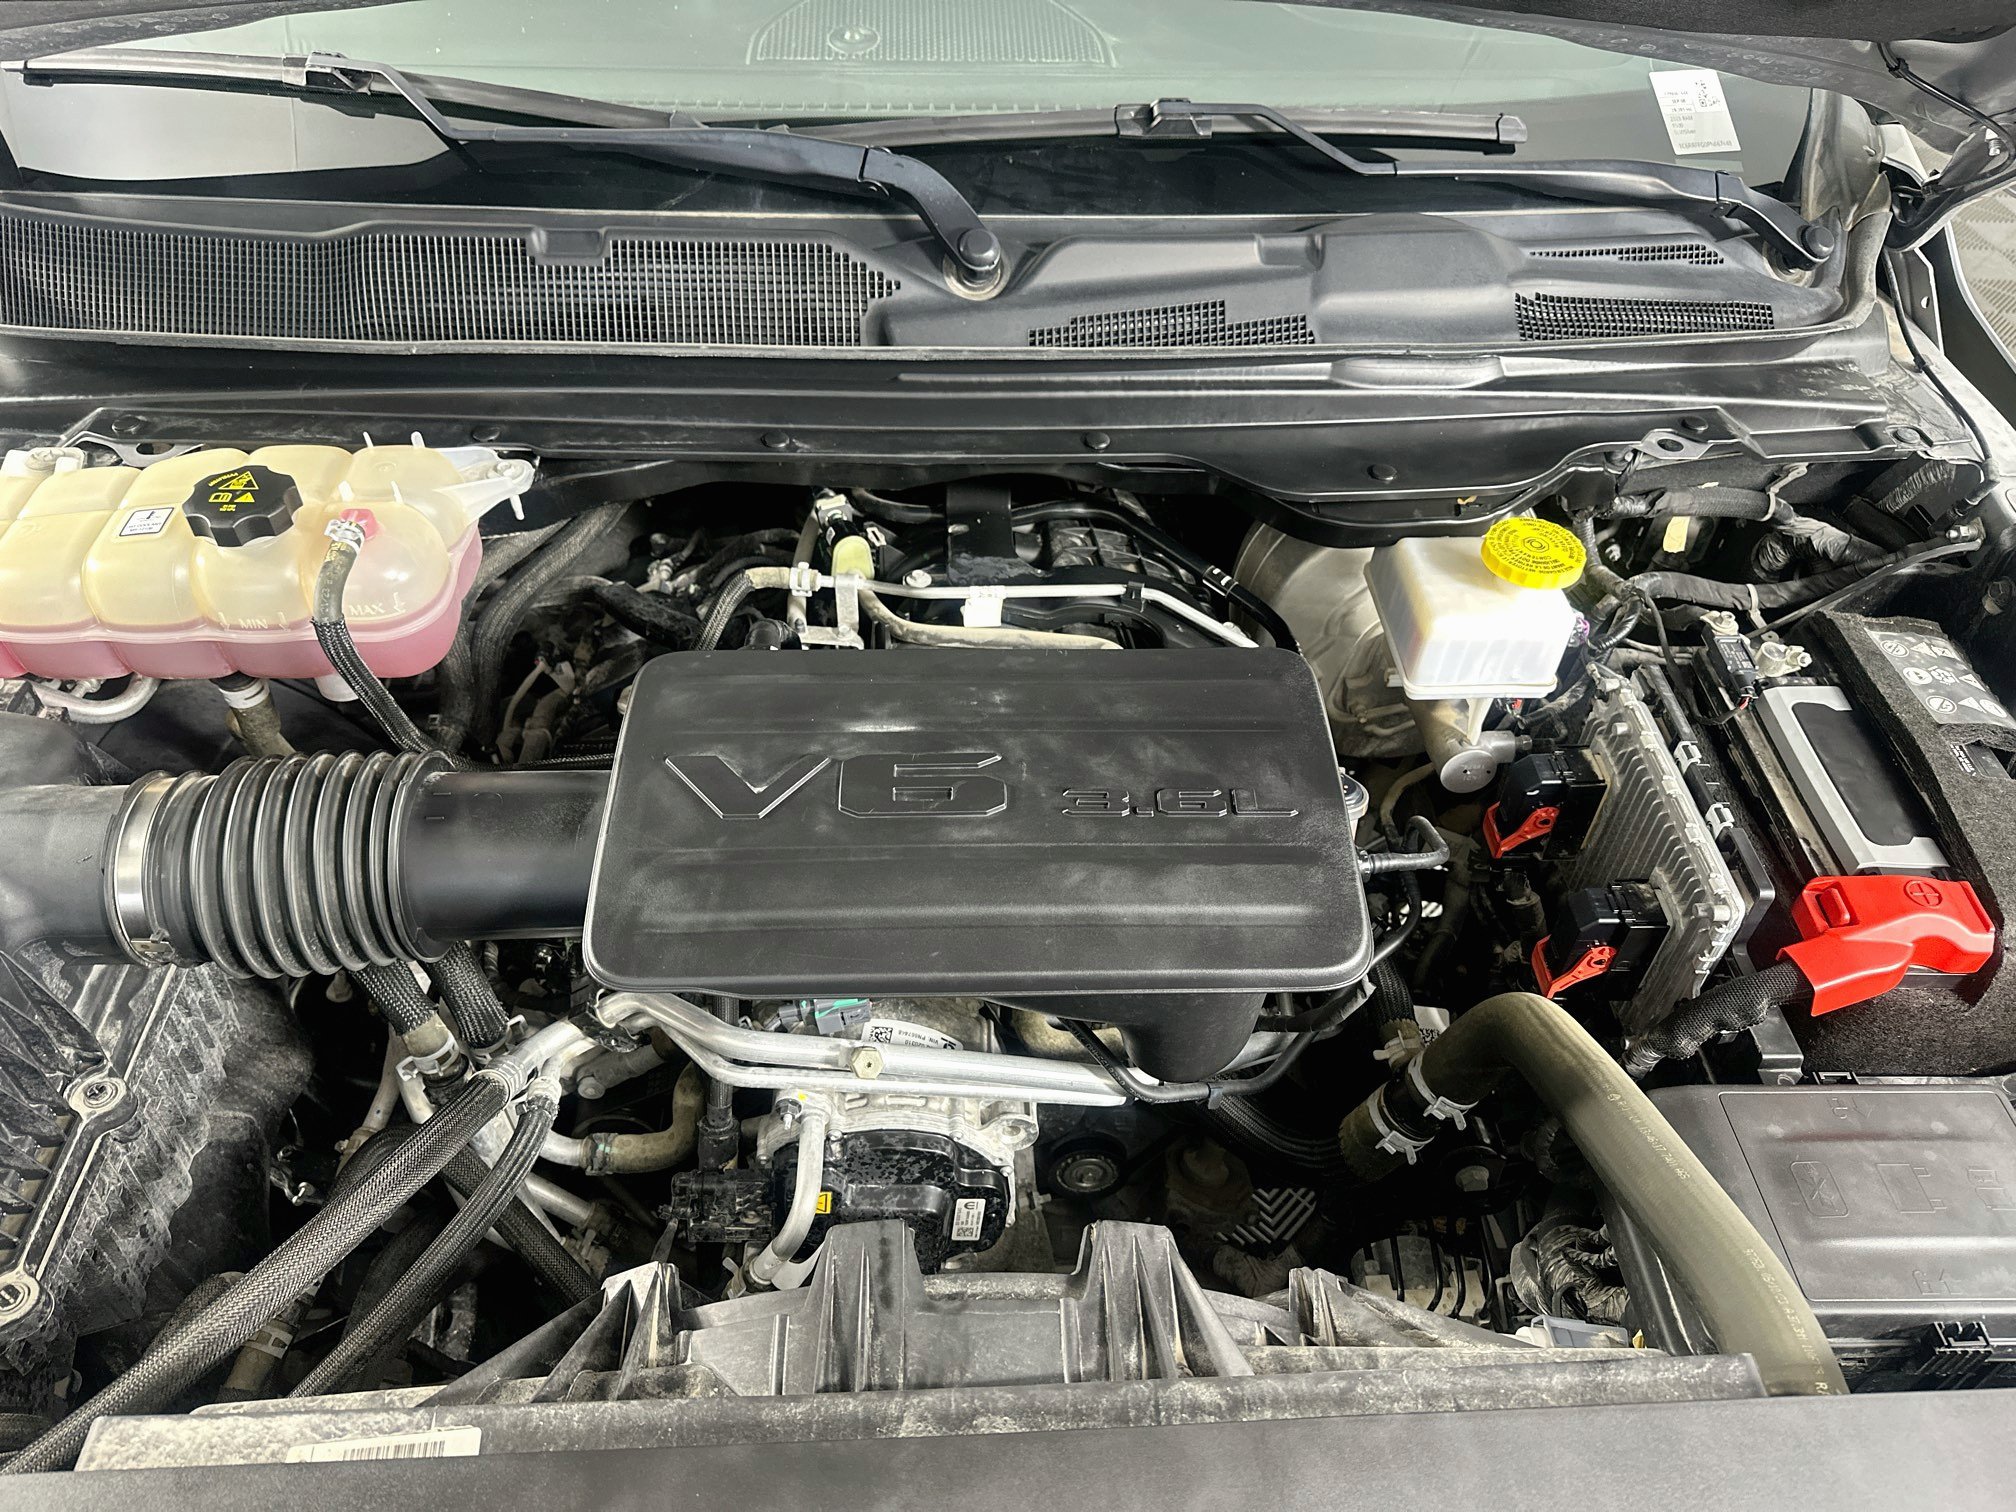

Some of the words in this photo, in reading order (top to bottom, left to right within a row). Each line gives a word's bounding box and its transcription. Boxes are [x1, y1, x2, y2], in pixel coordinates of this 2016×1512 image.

[349, 603, 386, 616] MAX
[238, 618, 269, 630] MIN
[664, 751, 1009, 820] V6
[1061, 786, 1299, 819] 3.6L
